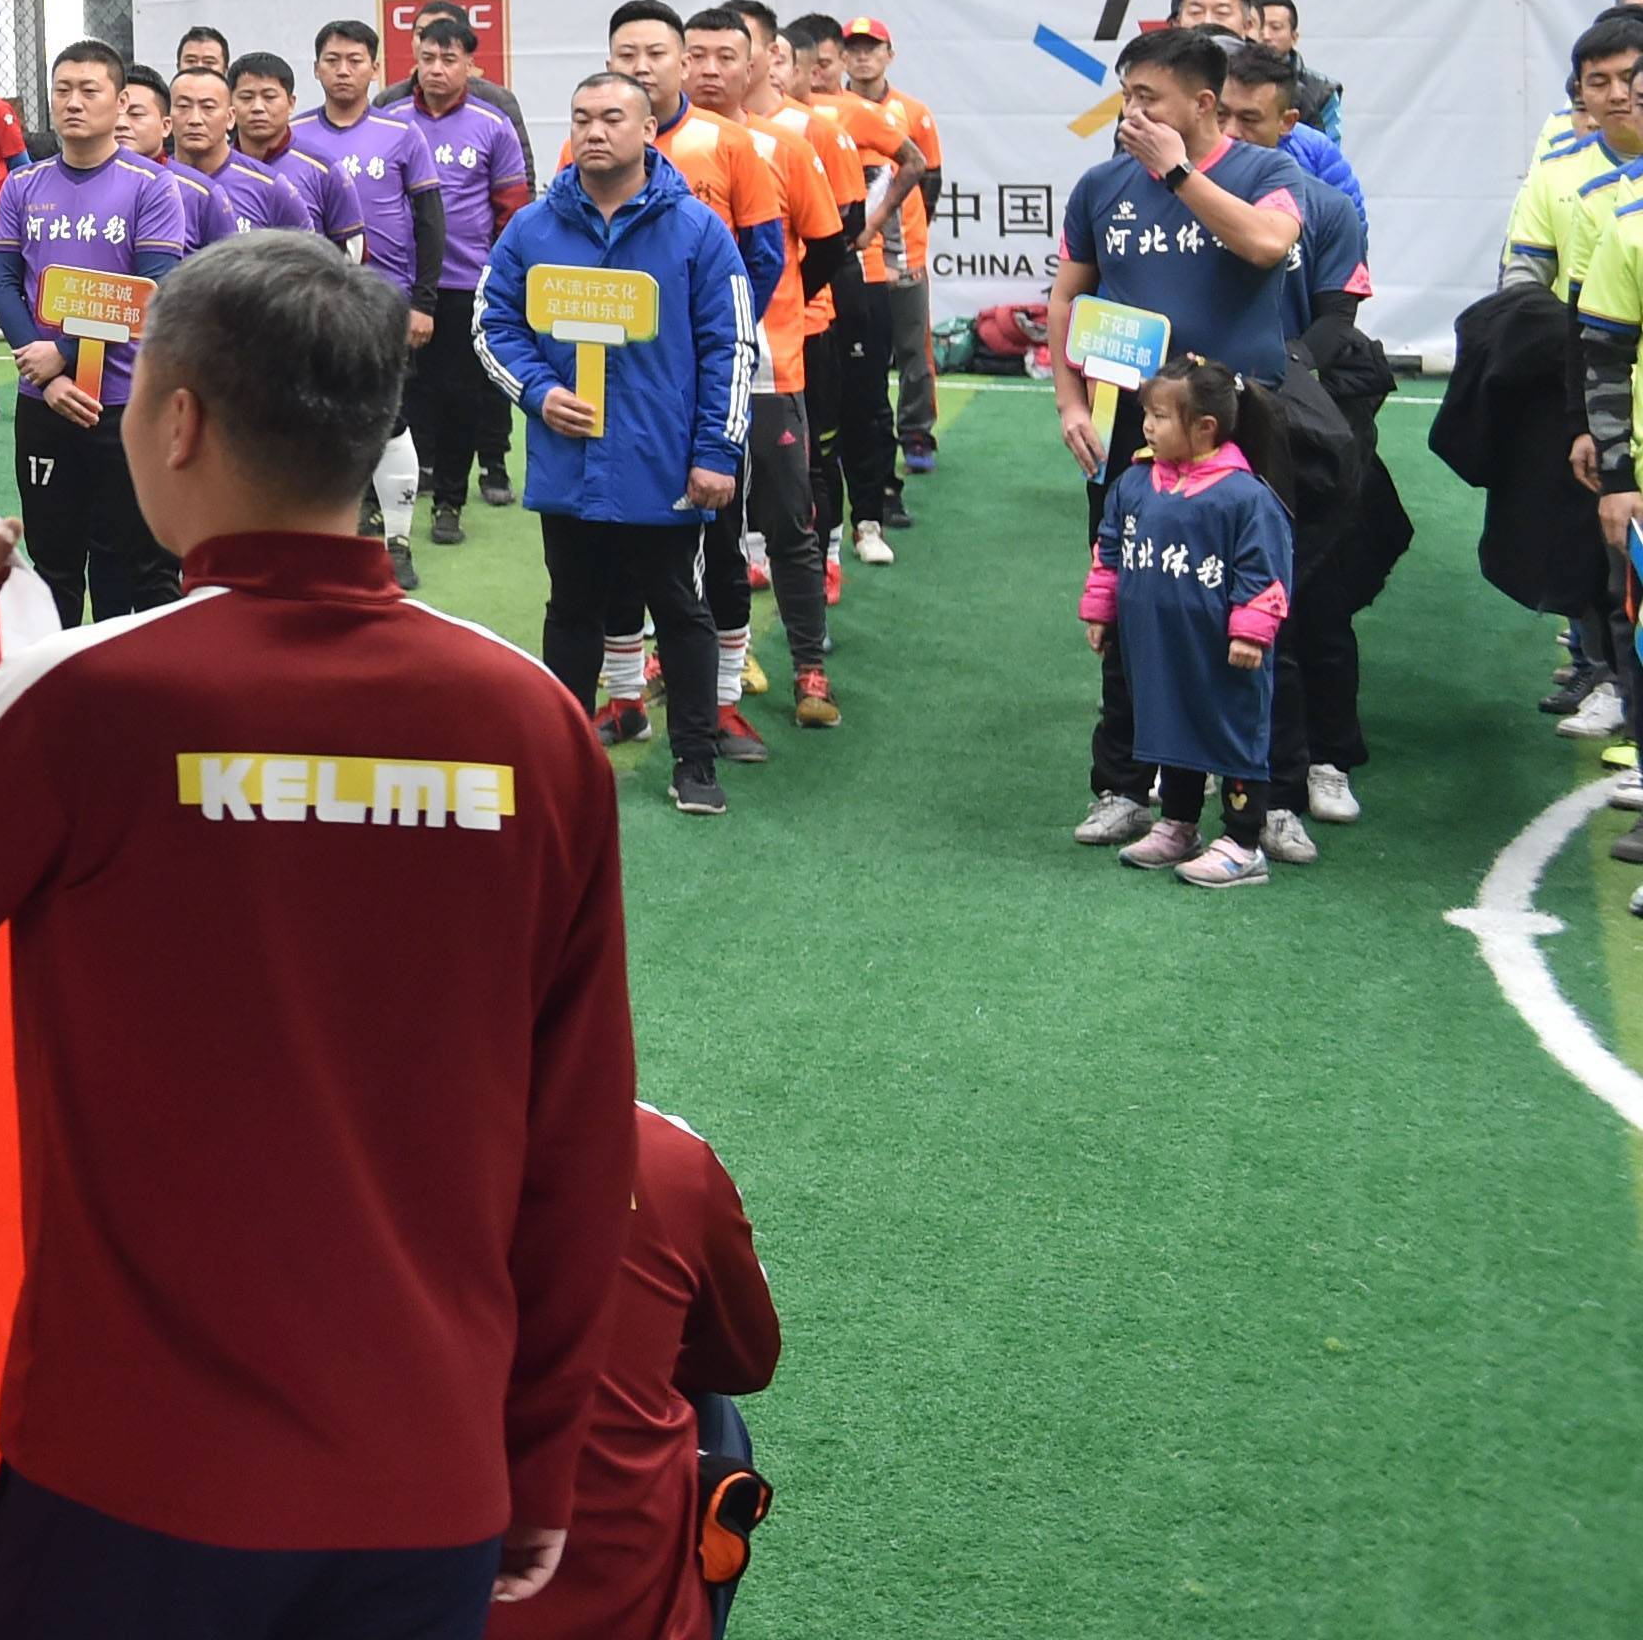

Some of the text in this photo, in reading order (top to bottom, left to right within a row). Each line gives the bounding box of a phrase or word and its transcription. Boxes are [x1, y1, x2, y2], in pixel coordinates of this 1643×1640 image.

[26, 214, 127, 244] 河北体彩
[1105, 221, 1227, 256] 河北体
[933, 253, 1033, 277] CHINA
[543, 277, 639, 301] AK流行文化
[52, 296, 141, 324] 足球俱乐部
[546, 298, 635, 321] 足球俱乐部
[1077, 332, 1152, 368] 足球俱乐部
[28, 456, 55, 486] 17
[1121, 538, 1226, 589] 河北体彩
[200, 758, 501, 831] KELME
